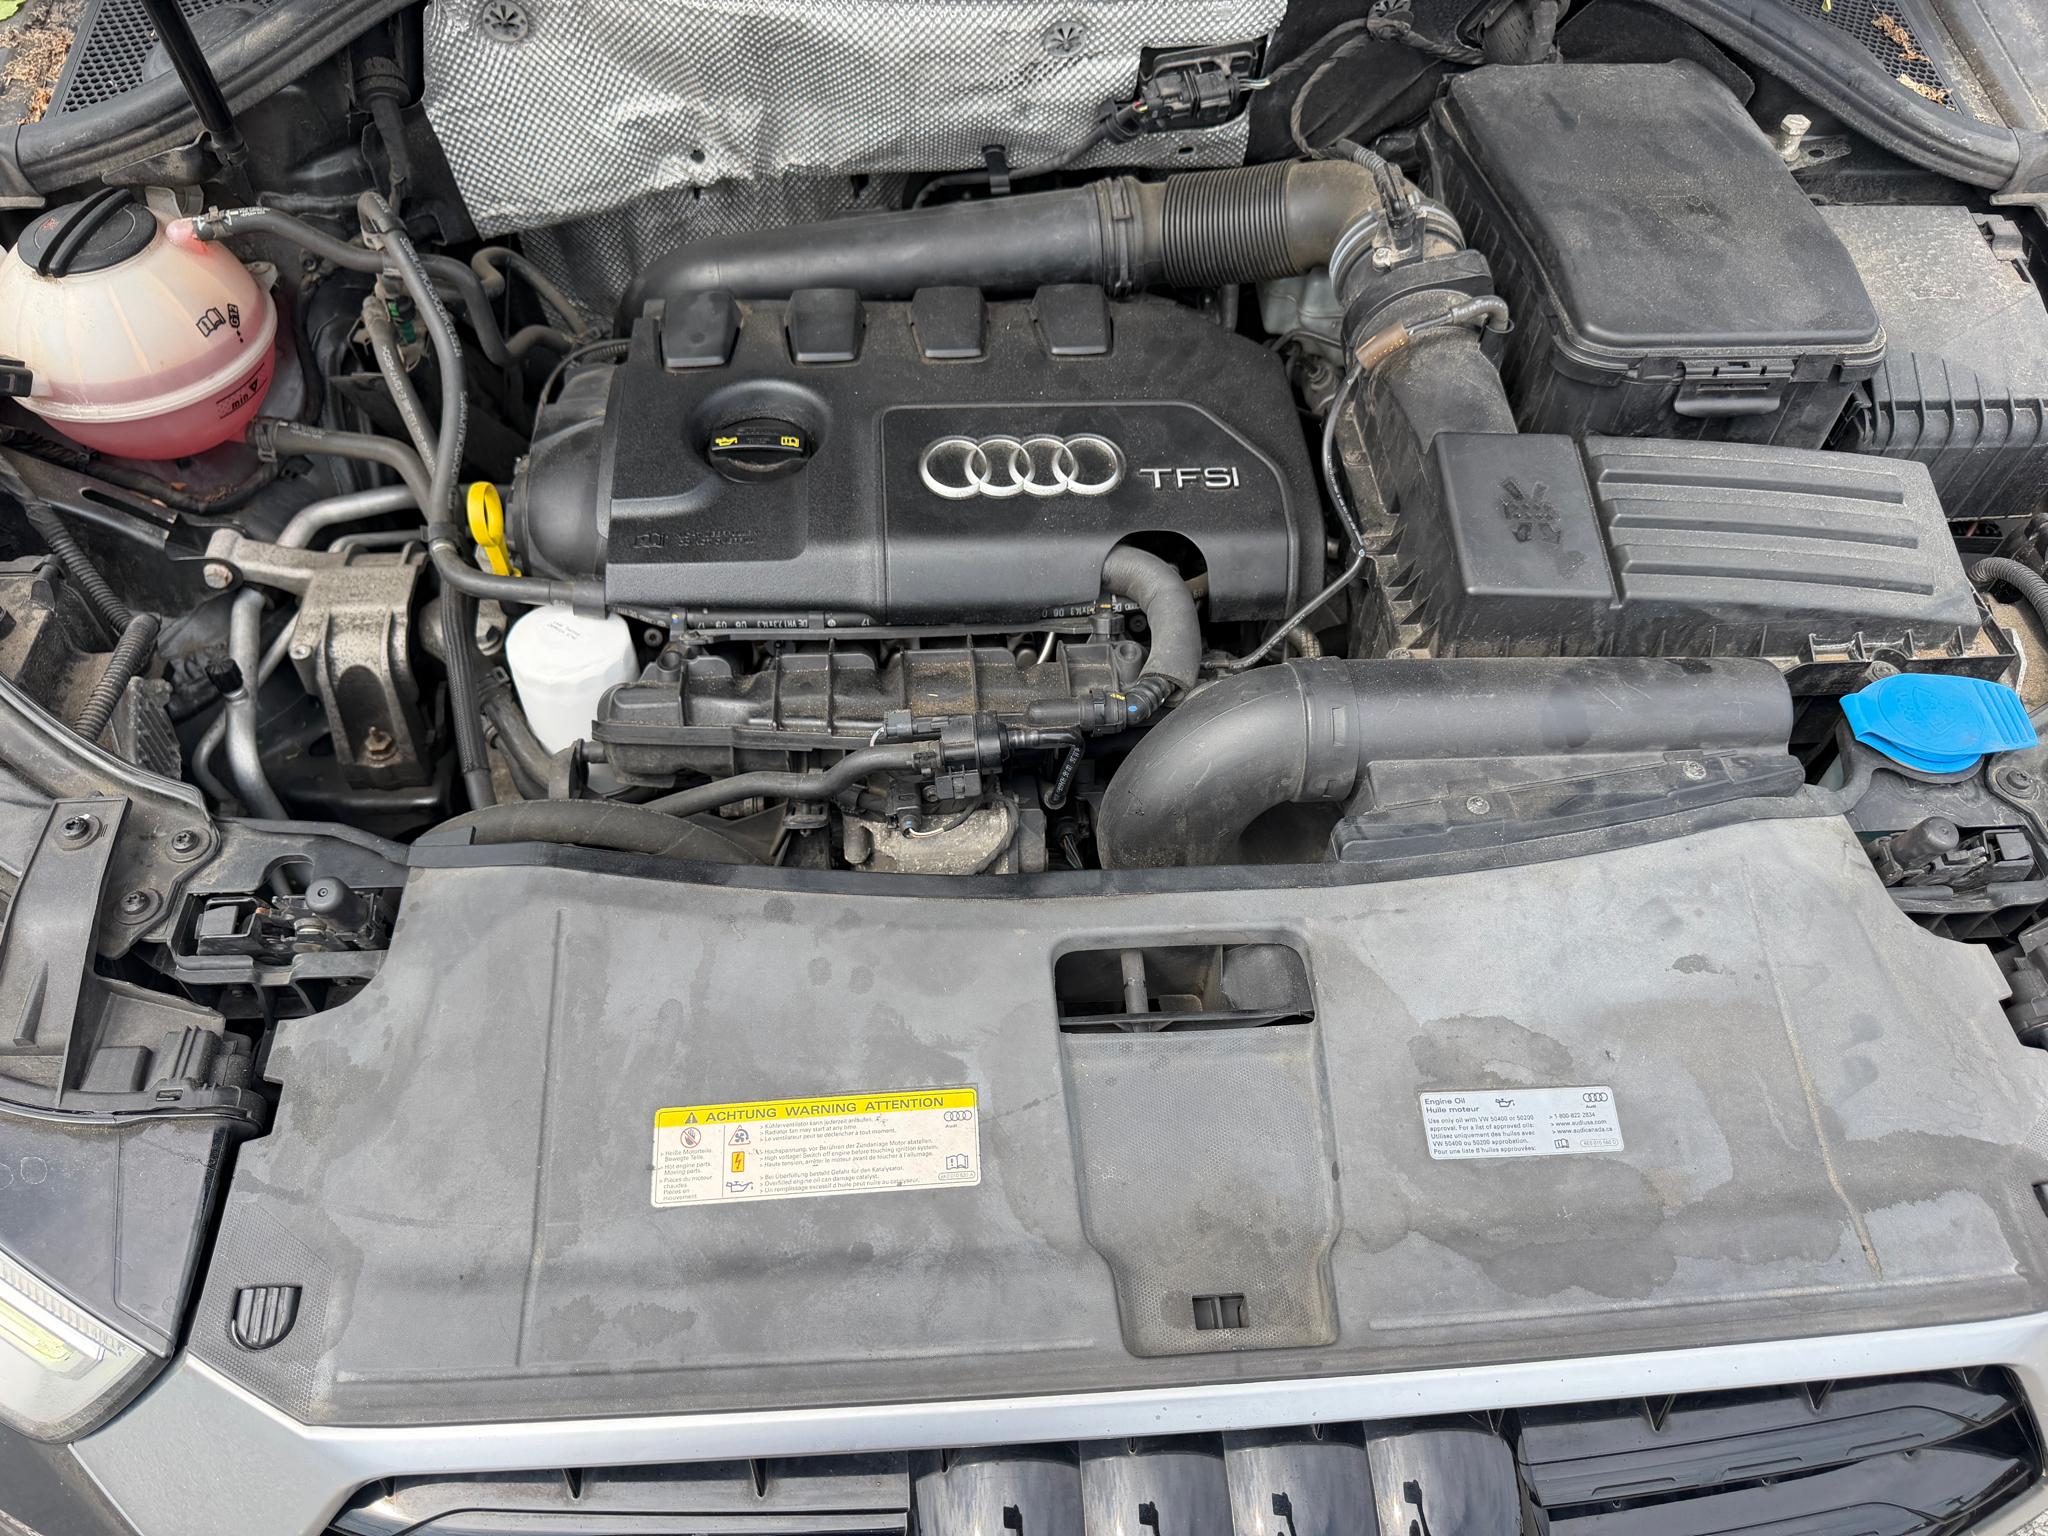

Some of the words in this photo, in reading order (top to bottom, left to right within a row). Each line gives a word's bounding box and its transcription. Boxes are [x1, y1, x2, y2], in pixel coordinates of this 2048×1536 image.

[231, 392, 249, 410] min
[1139, 466, 1240, 489] TFSI
[705, 1108, 777, 1122] ACHTUNG
[785, 1102, 857, 1116] WARNING
[865, 1097, 944, 1111] ATTENTION
[1425, 1098, 1452, 1106] Engine
